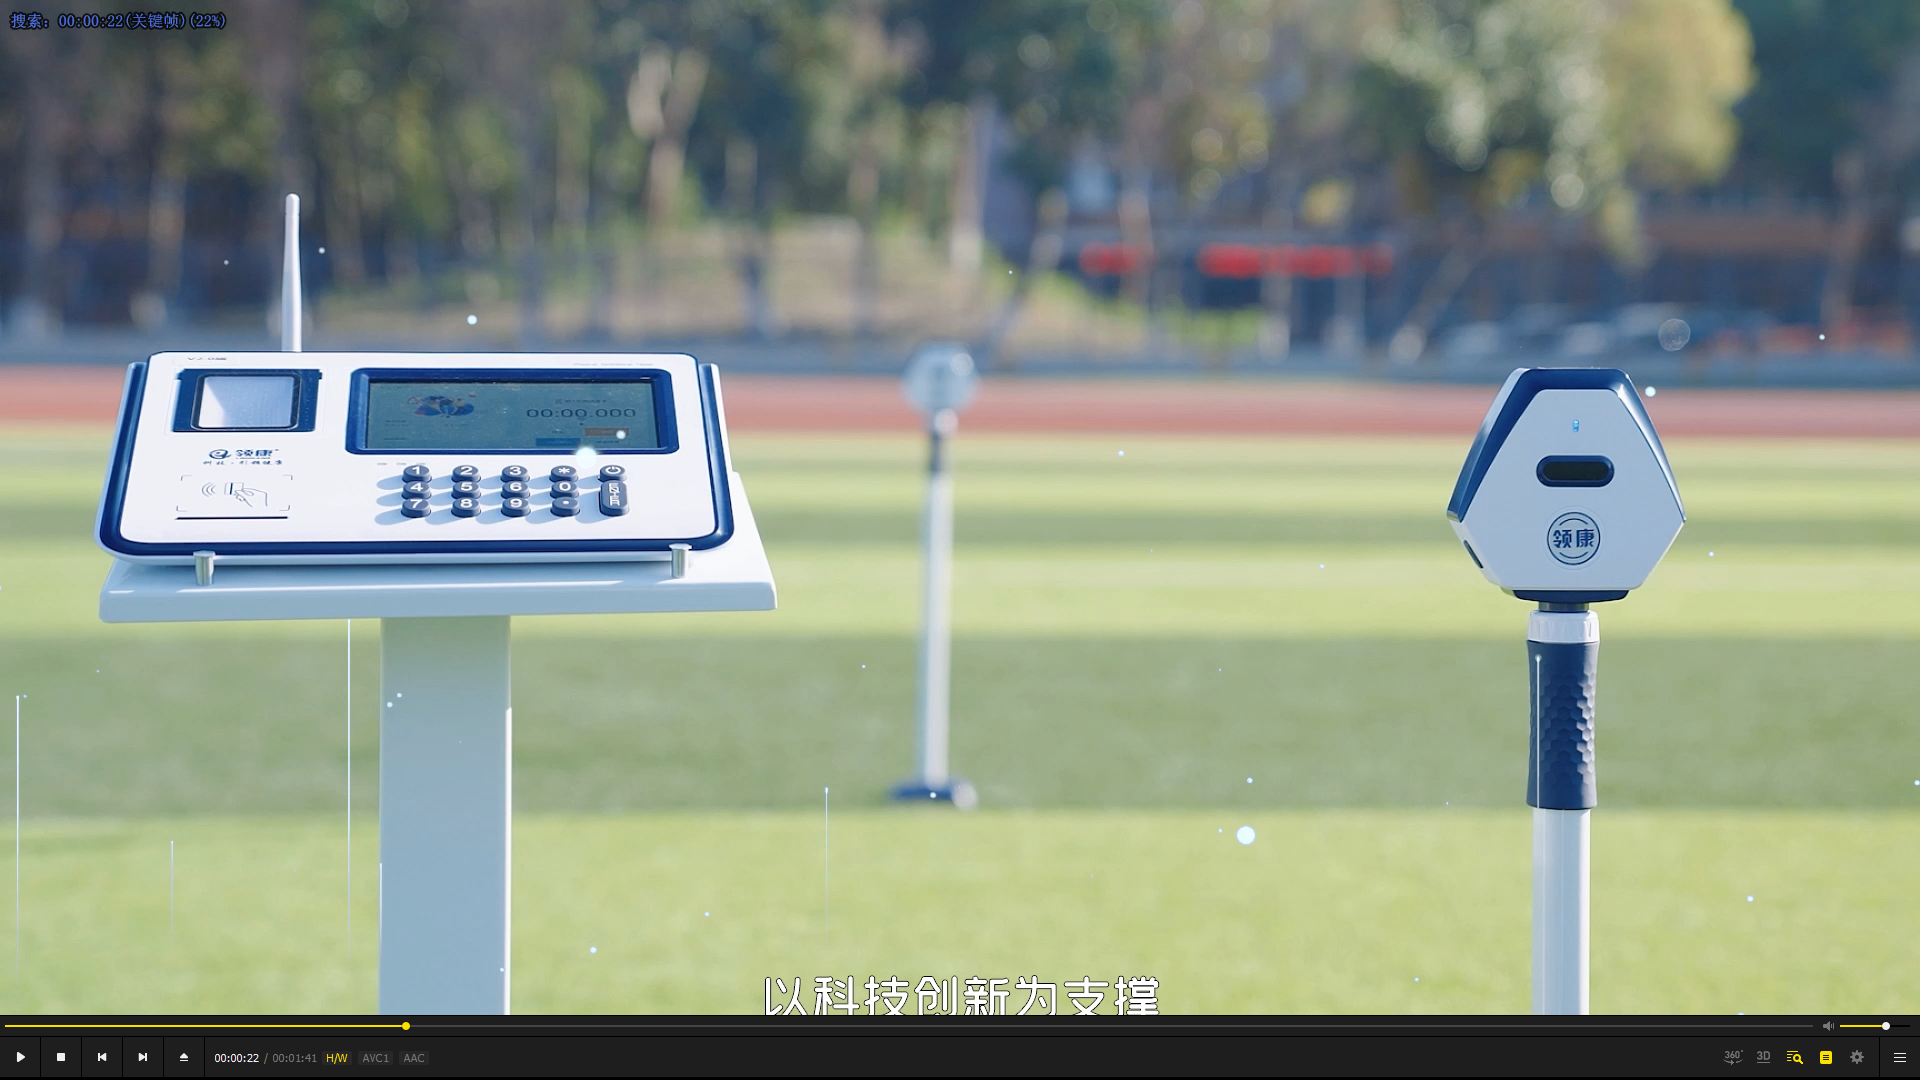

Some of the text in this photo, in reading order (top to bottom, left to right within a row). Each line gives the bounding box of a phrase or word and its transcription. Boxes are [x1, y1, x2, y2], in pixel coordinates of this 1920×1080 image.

[526, 408, 637, 418] 00:00.000
[411, 466, 522, 475] 1 2 3
[410, 482, 571, 492] 4 5 6 0
[410, 499, 522, 509] 7 8 9
[1552, 528, 1595, 549] 领康
